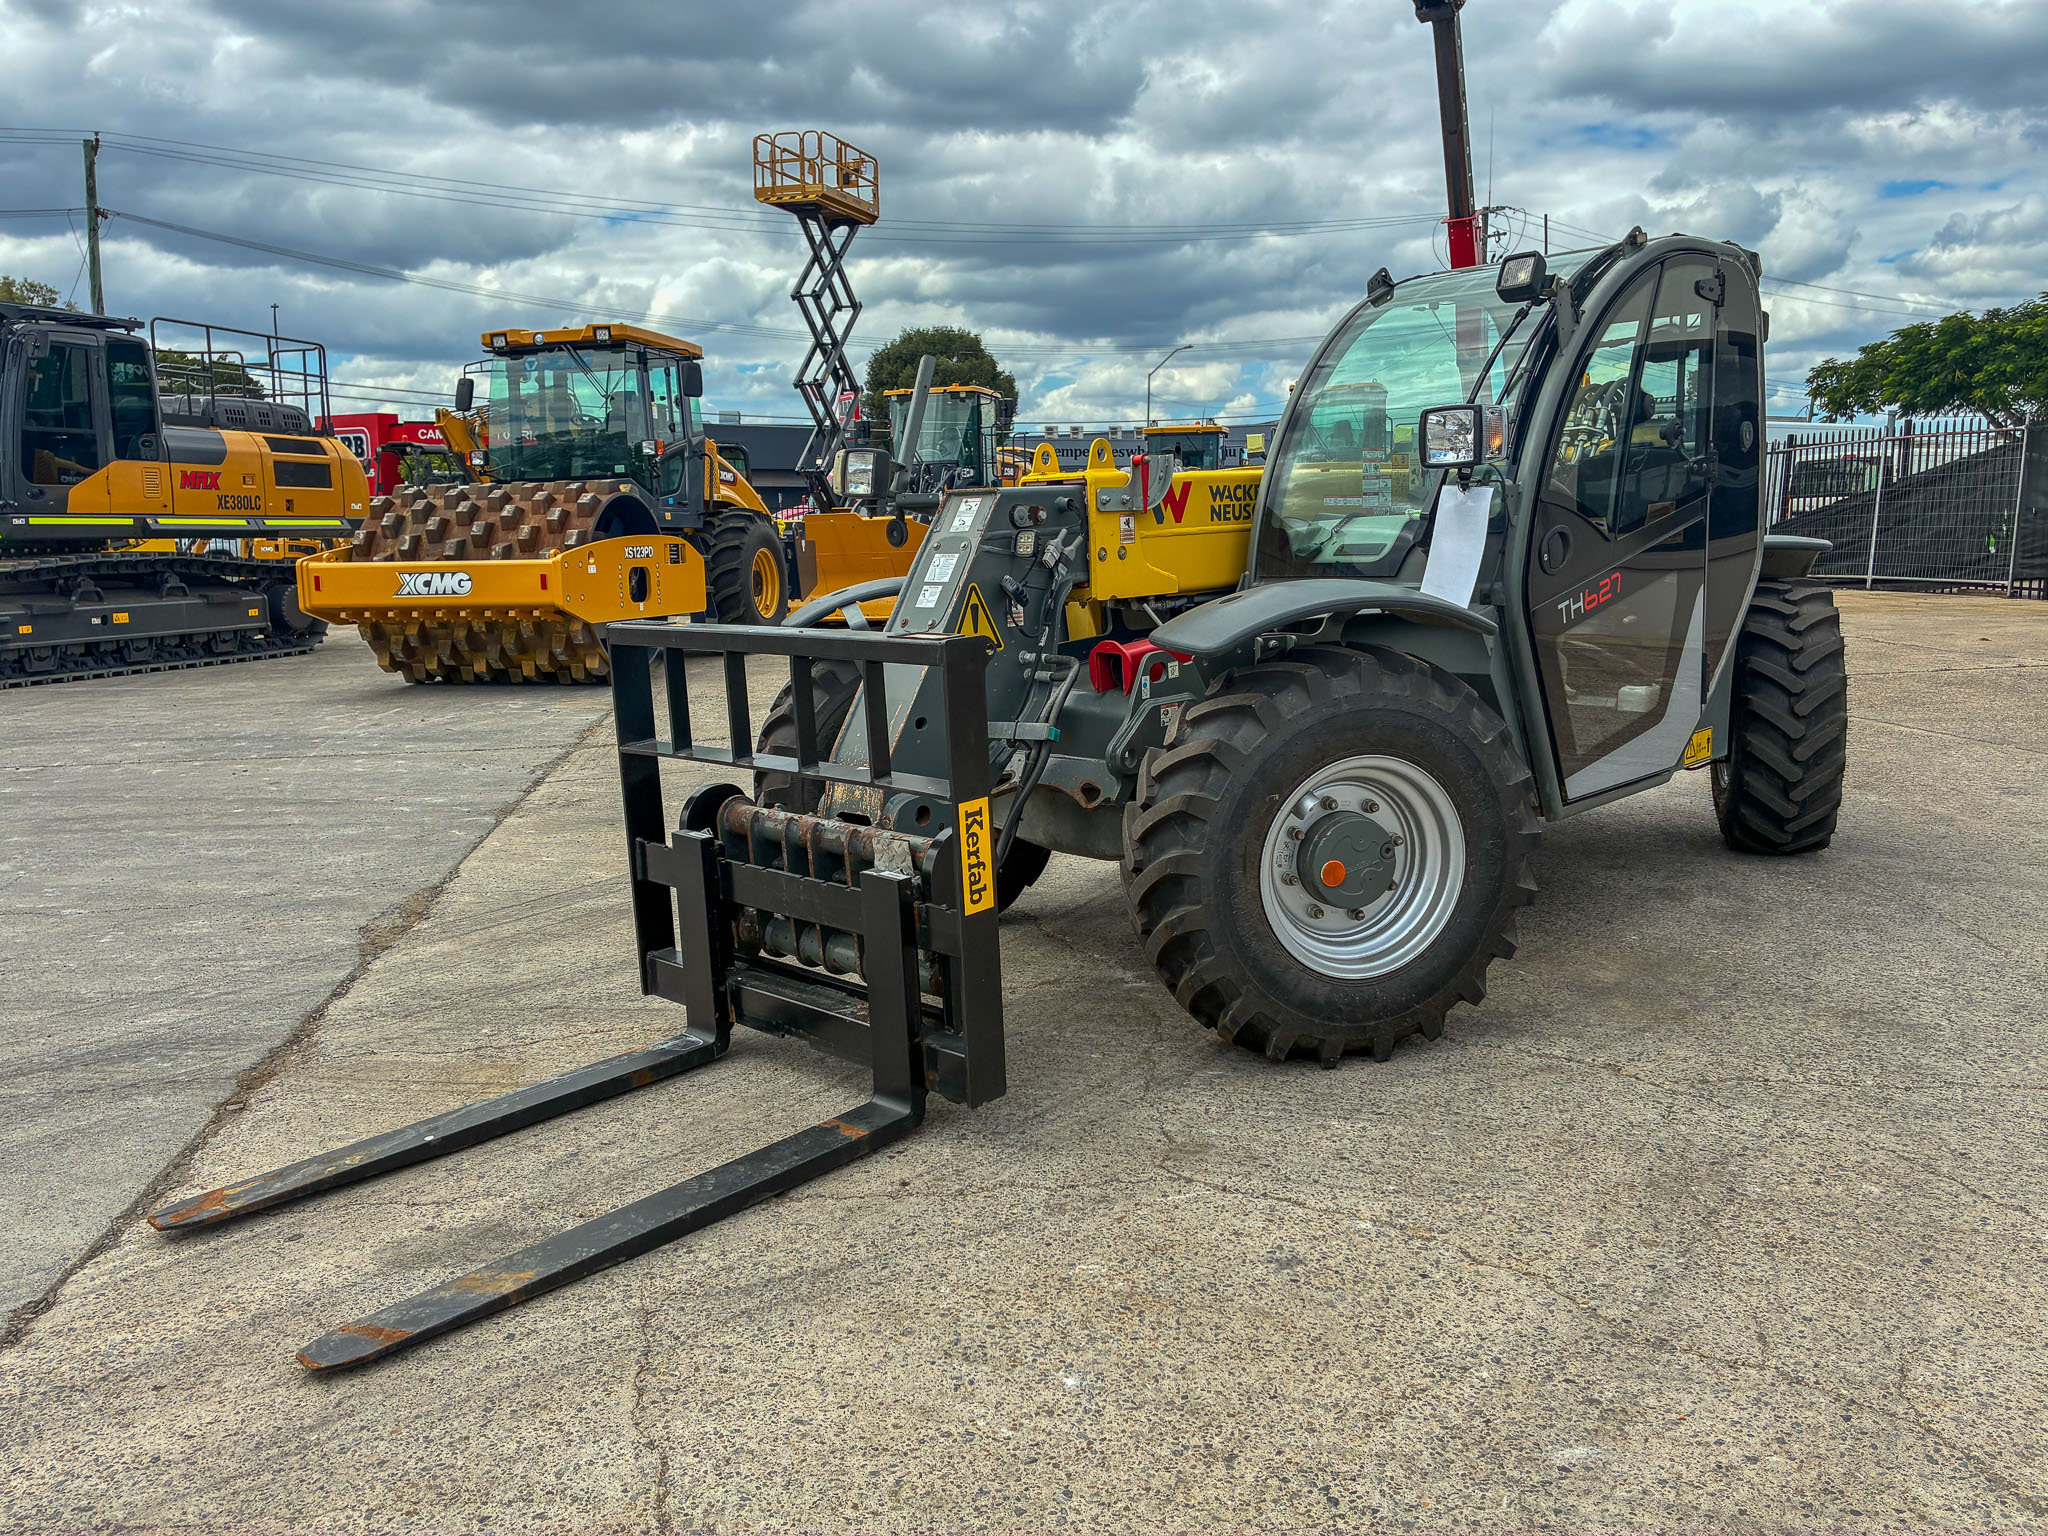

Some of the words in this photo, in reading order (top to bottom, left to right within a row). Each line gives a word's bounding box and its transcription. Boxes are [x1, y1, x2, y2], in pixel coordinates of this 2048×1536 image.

[216, 494, 262, 511] XE380LC
[1209, 503, 1256, 522] NEUS
[623, 545, 654, 559] XS123PD
[396, 571, 473, 596] XCMG
[1557, 571, 1622, 624] TH627
[964, 806, 988, 905] Kerfab
